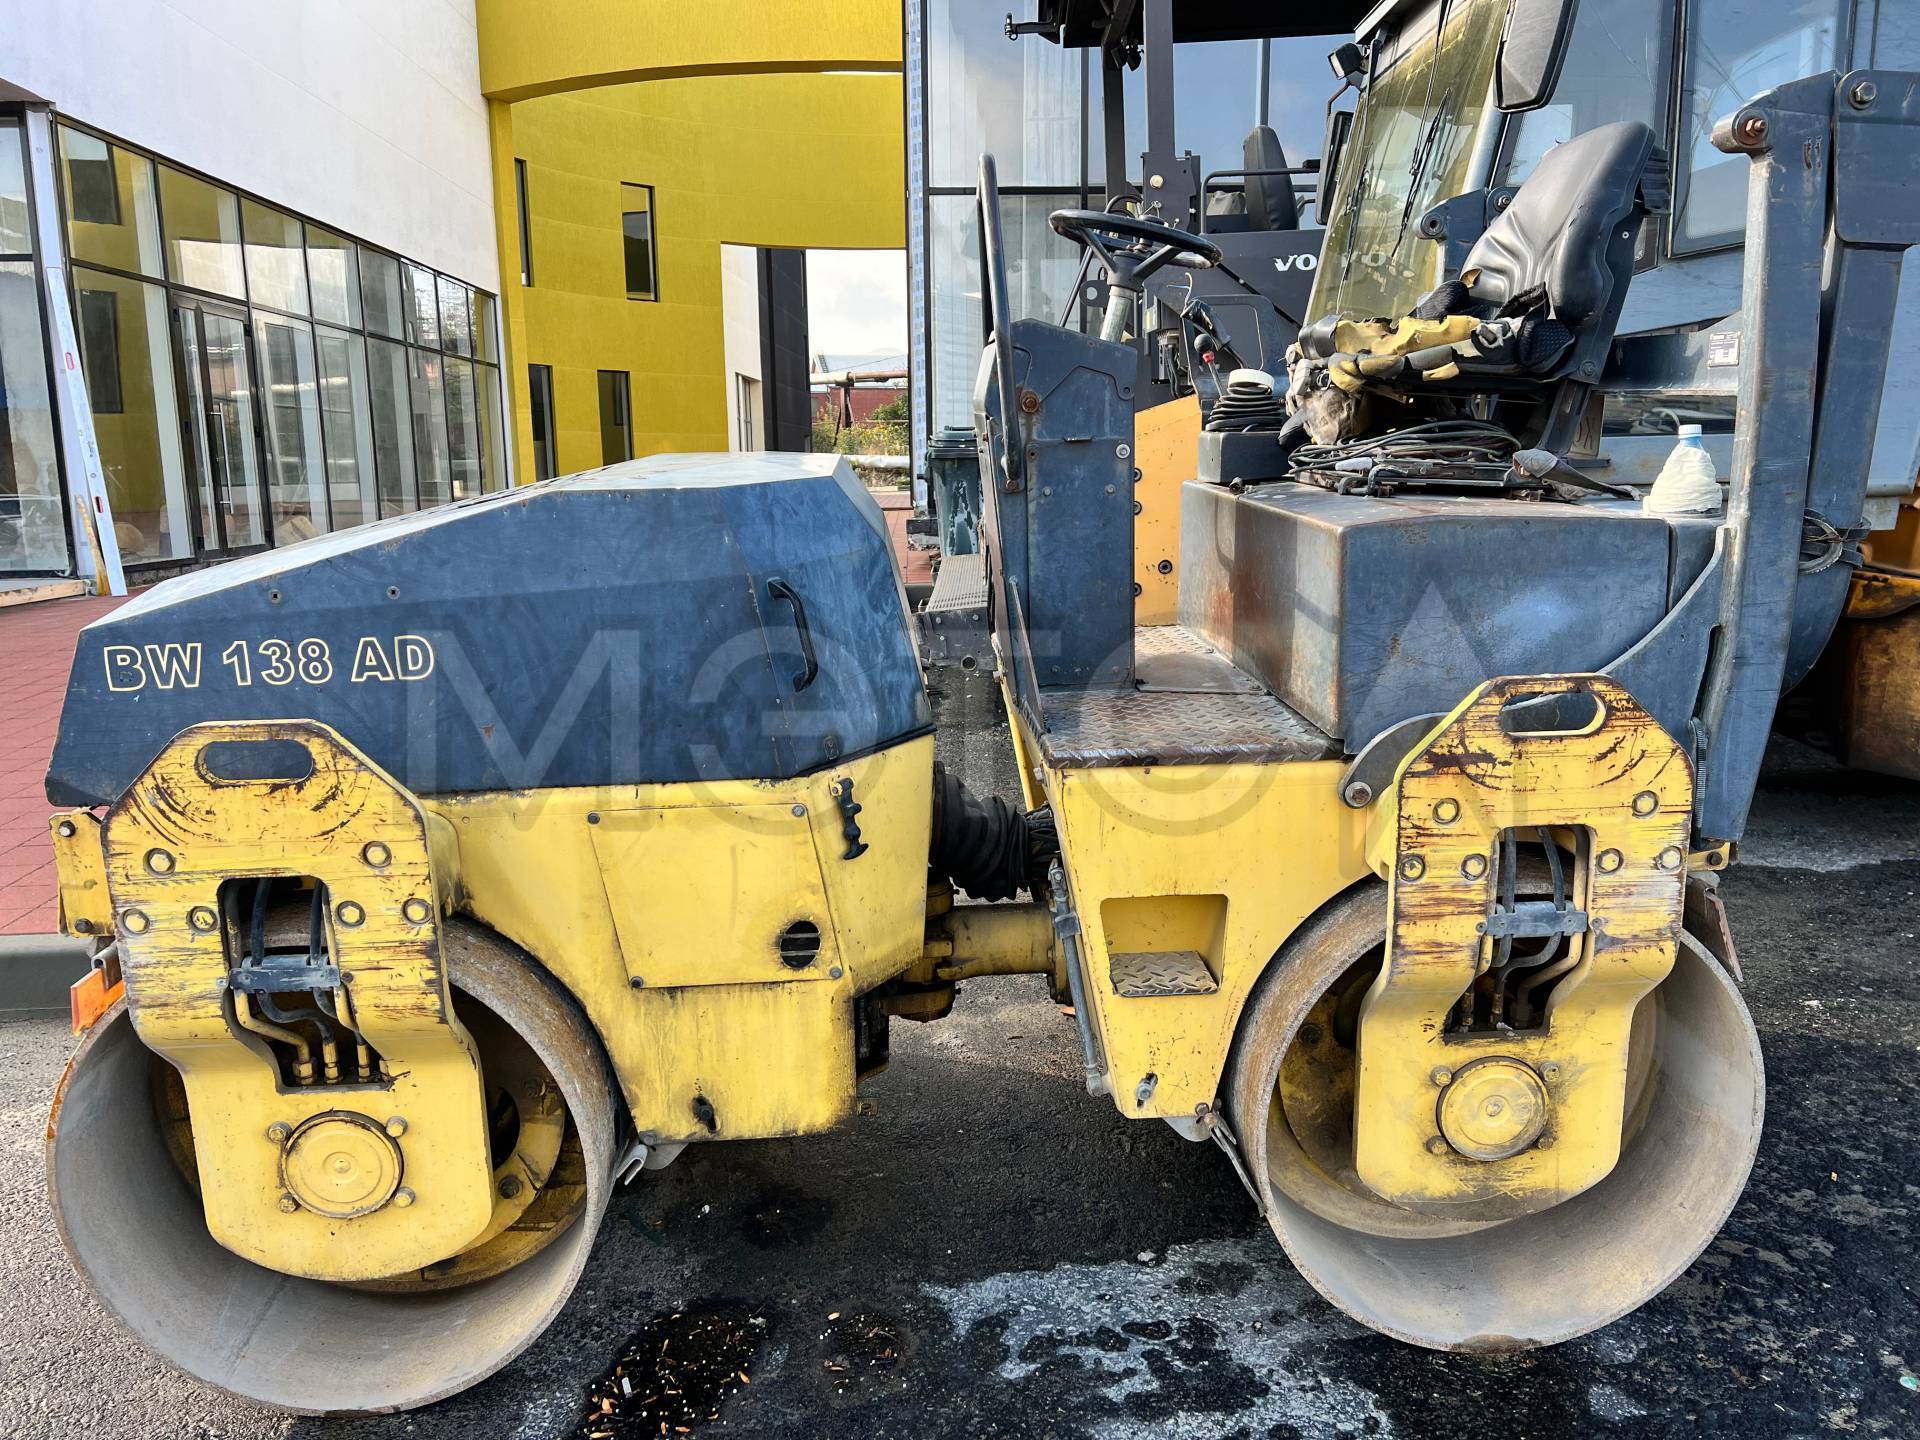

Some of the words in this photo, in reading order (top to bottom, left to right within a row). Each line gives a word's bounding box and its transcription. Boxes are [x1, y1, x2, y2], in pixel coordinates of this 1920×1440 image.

[103, 642, 202, 692] BW
[222, 637, 333, 686] 138
[350, 634, 434, 682] AD
